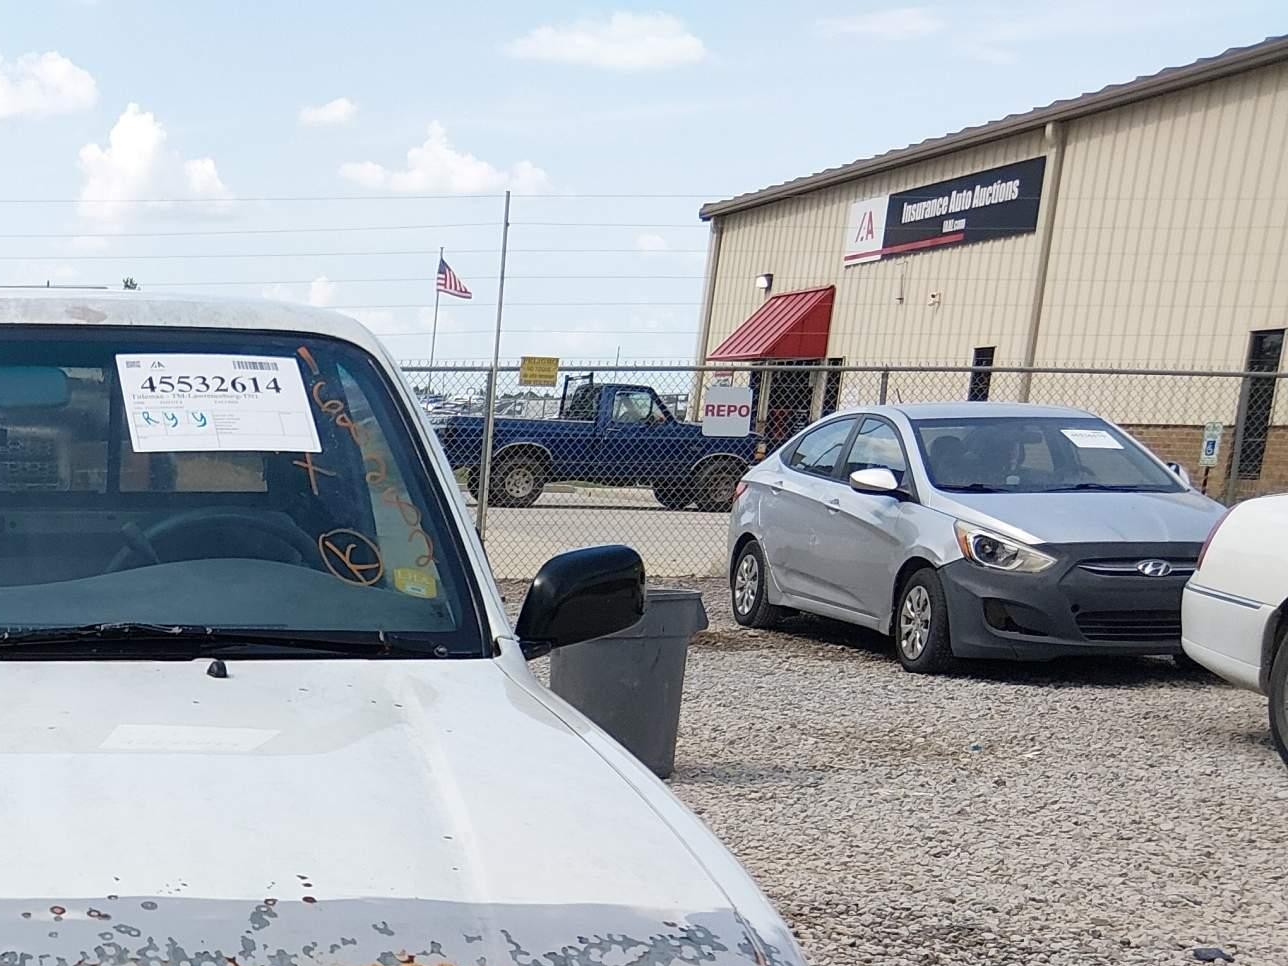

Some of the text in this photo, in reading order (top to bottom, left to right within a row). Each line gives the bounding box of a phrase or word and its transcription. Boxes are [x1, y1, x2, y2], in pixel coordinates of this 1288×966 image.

[901, 179, 1020, 224] Insurance Auto Auctions
[141, 376, 282, 394] 45532614
[142, 411, 160, 426] R
[704, 404, 750, 417] REPO
